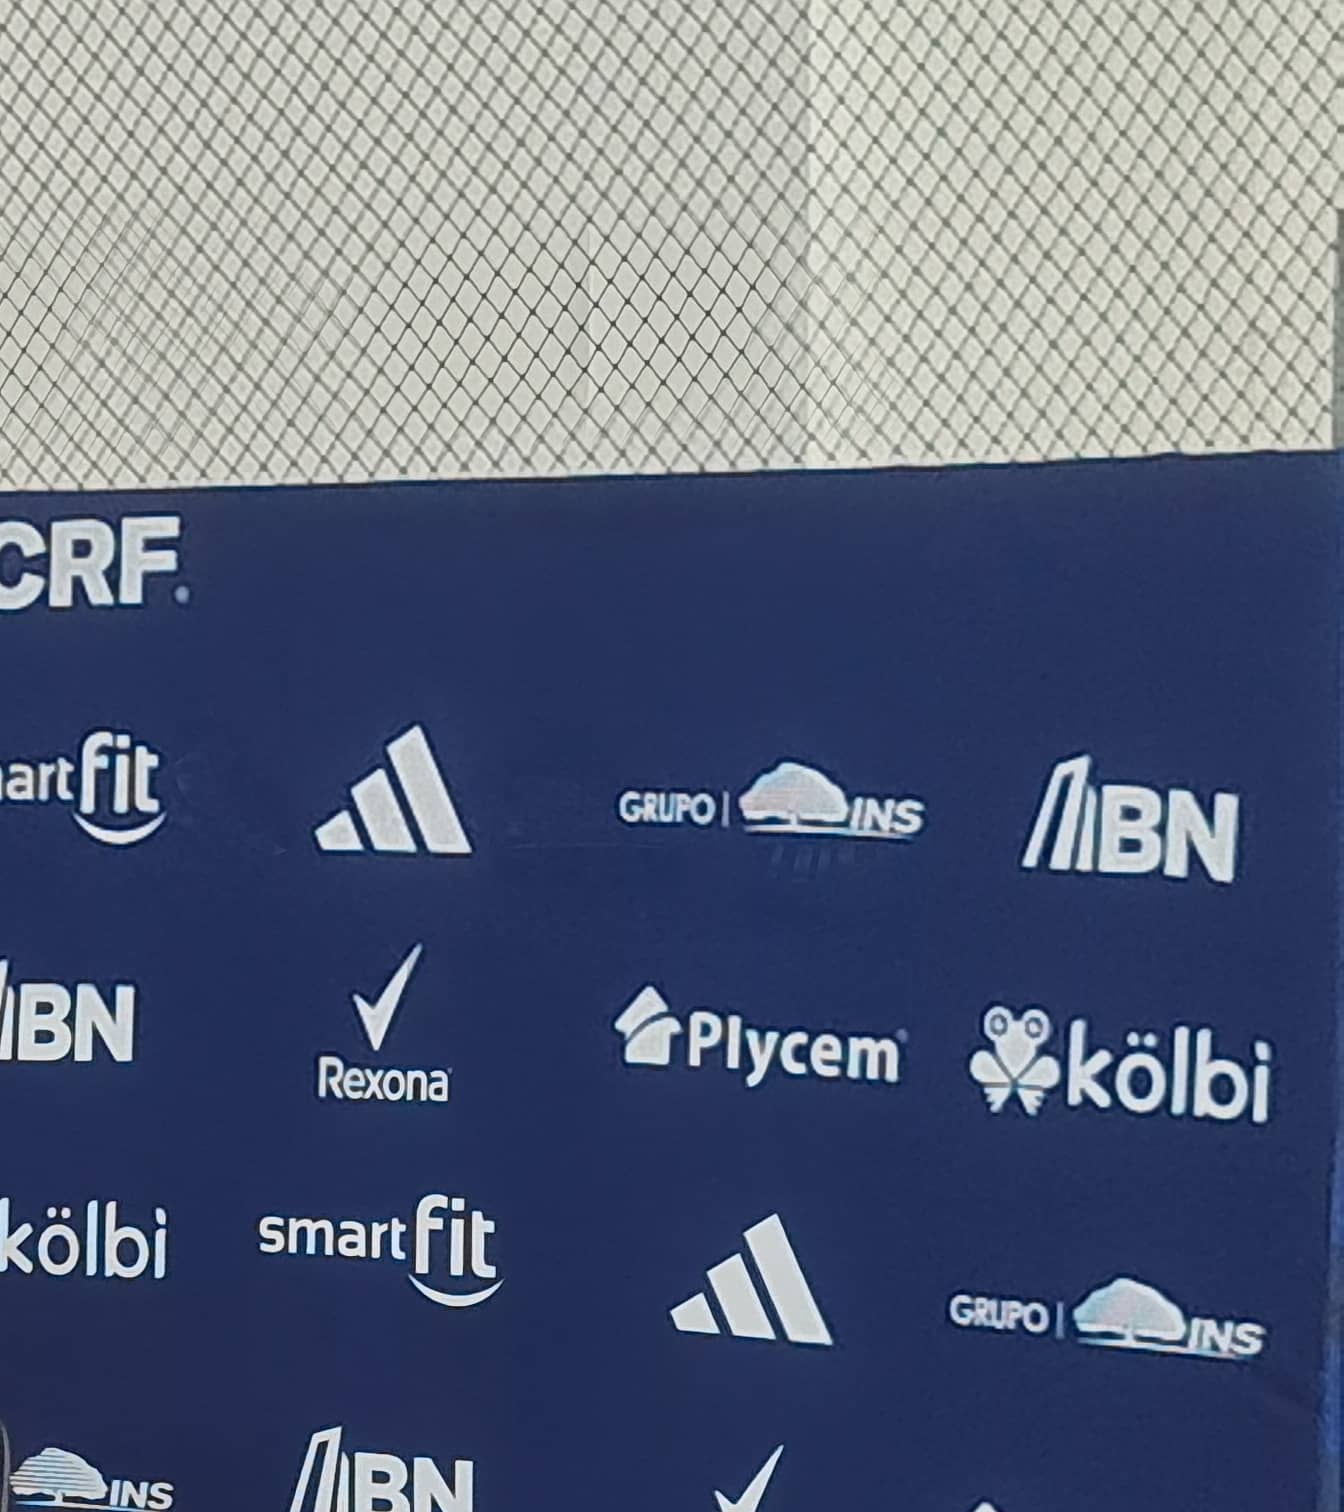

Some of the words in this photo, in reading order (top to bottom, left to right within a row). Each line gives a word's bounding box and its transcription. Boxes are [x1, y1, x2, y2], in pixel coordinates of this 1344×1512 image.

[620, 791, 715, 824] GRUPO
[849, 798, 924, 832] INS
[1098, 785, 1238, 882] BN
[18, 984, 134, 1061] BN
[689, 1012, 898, 1087] Plycem
[319, 1057, 448, 1101] Rexona
[1068, 1020, 1270, 1122] kölbi
[950, 1295, 1049, 1332] GRUPO
[1187, 1319, 1264, 1355] INS
[110, 1481, 173, 1509] INS
